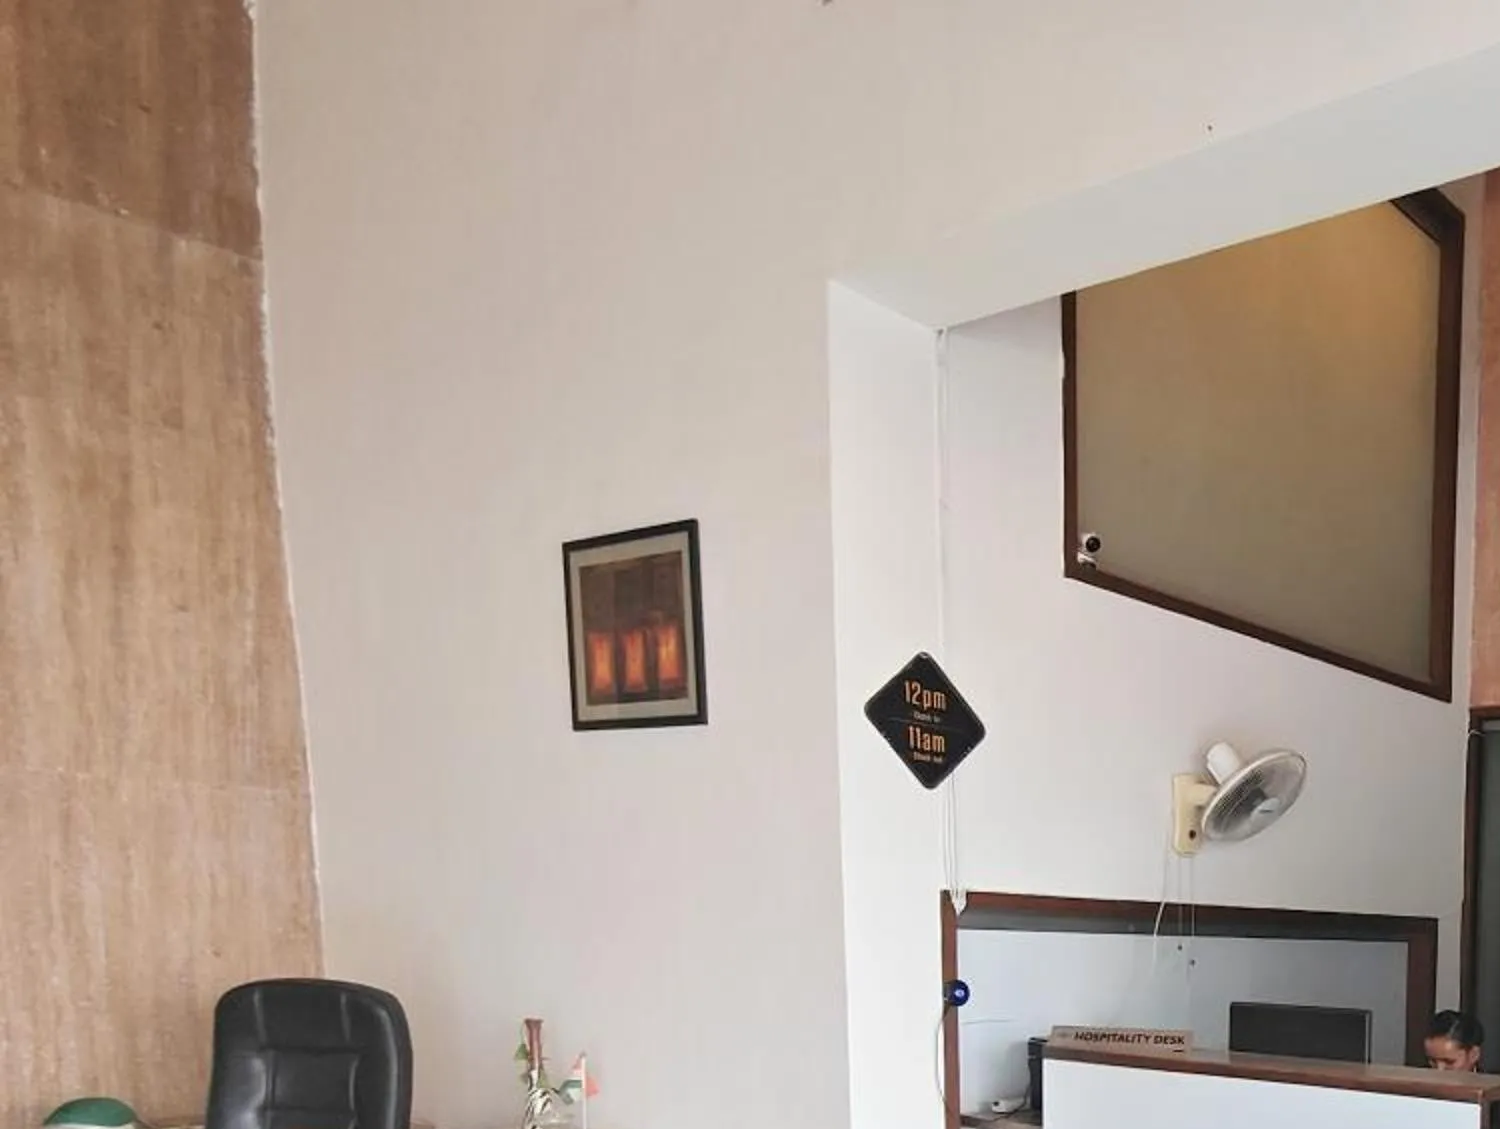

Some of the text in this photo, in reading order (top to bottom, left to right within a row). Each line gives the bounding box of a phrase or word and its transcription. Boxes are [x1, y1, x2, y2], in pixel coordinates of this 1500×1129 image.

[905, 681, 946, 710] 12pm
[909, 726, 945, 752] 11am
[1074, 1032, 1185, 1044] HOSPITALITY DESK
